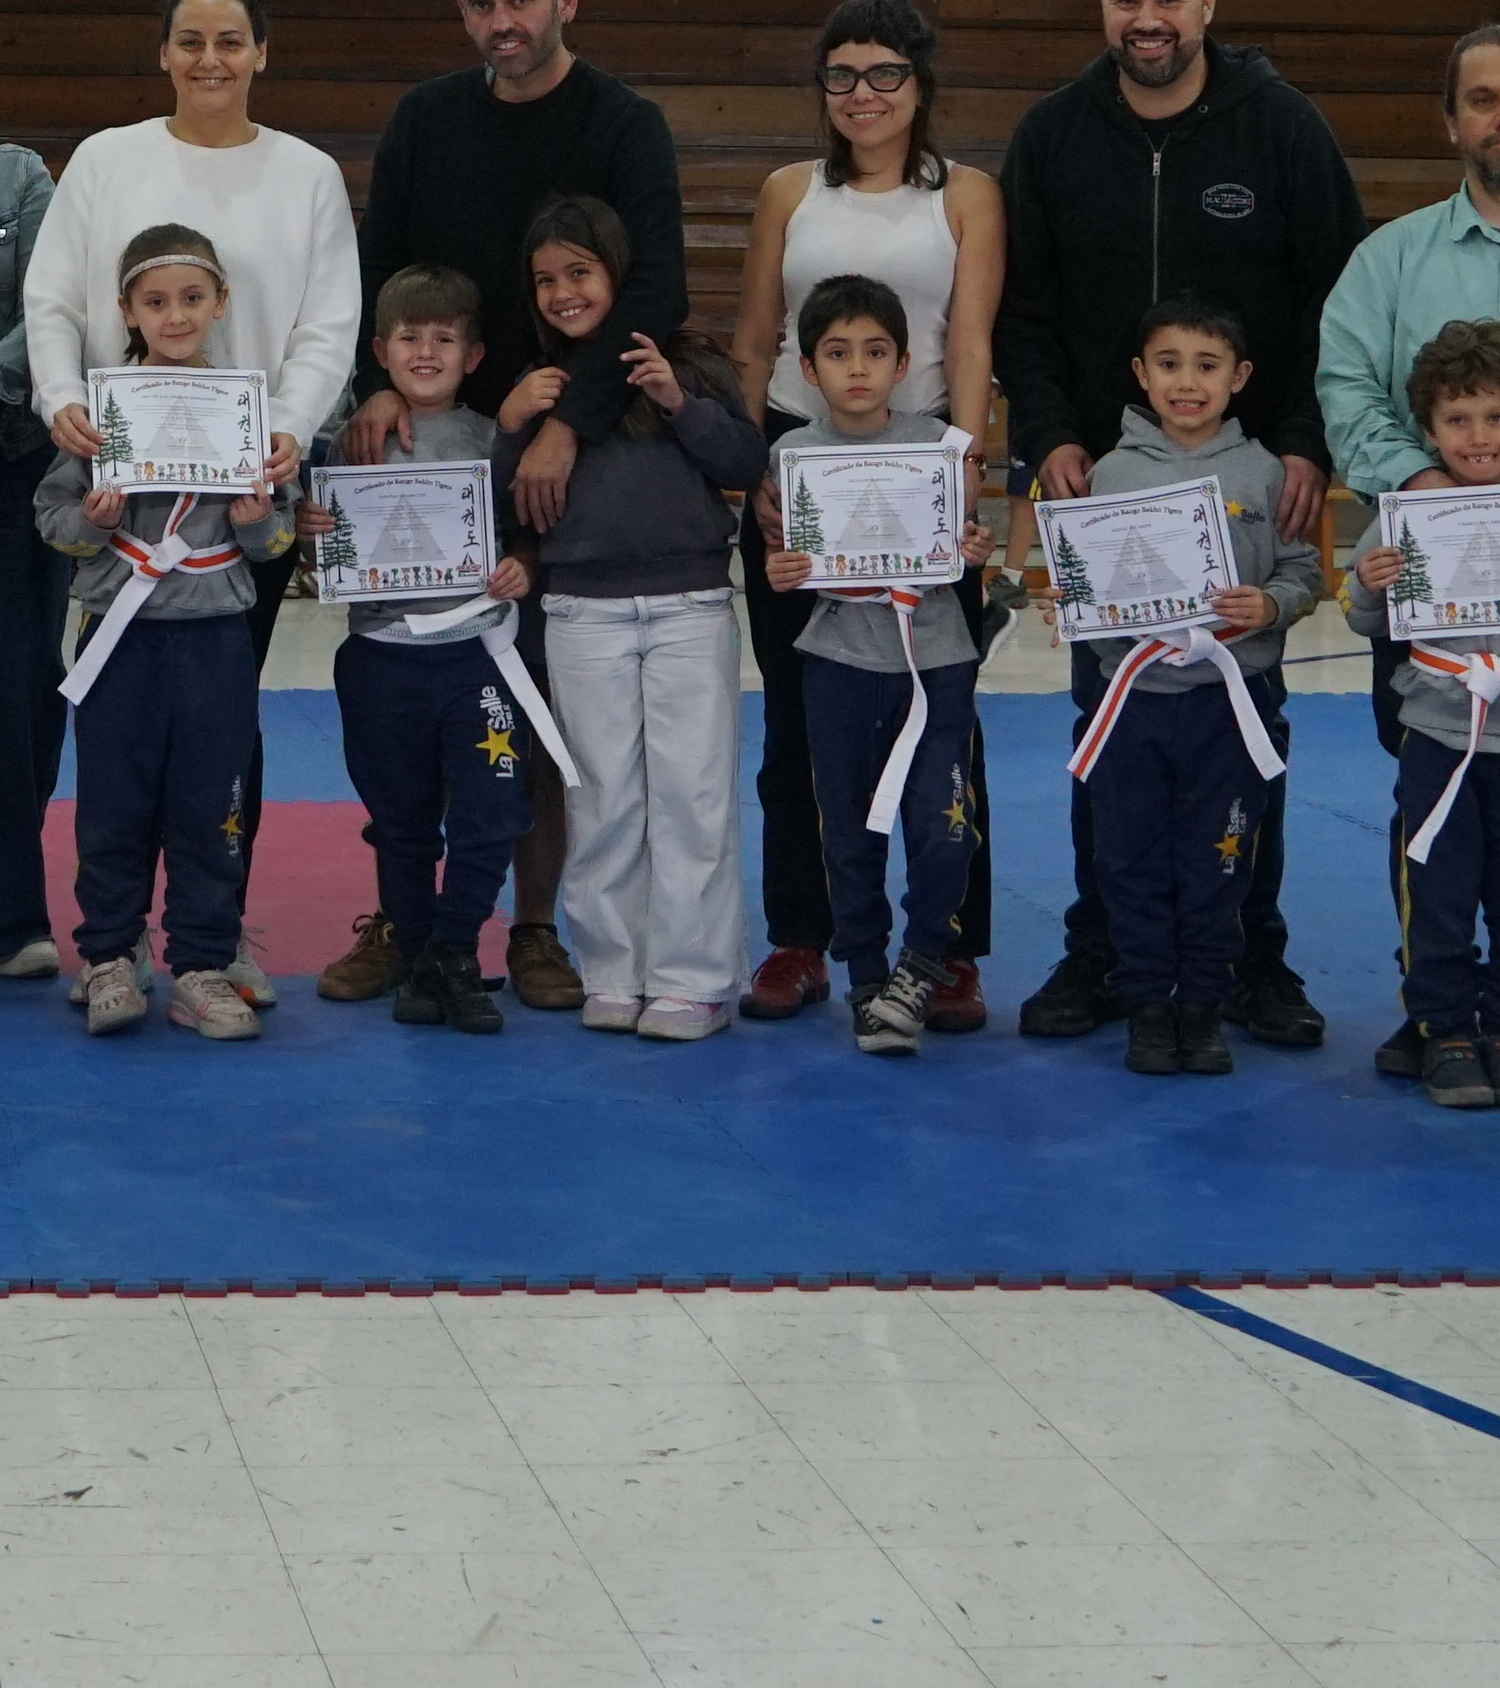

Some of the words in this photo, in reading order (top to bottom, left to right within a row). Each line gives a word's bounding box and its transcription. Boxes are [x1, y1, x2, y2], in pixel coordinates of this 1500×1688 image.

[480, 686, 506, 730] Salle
[496, 757, 513, 777] La
[1223, 856, 1234, 874] La
